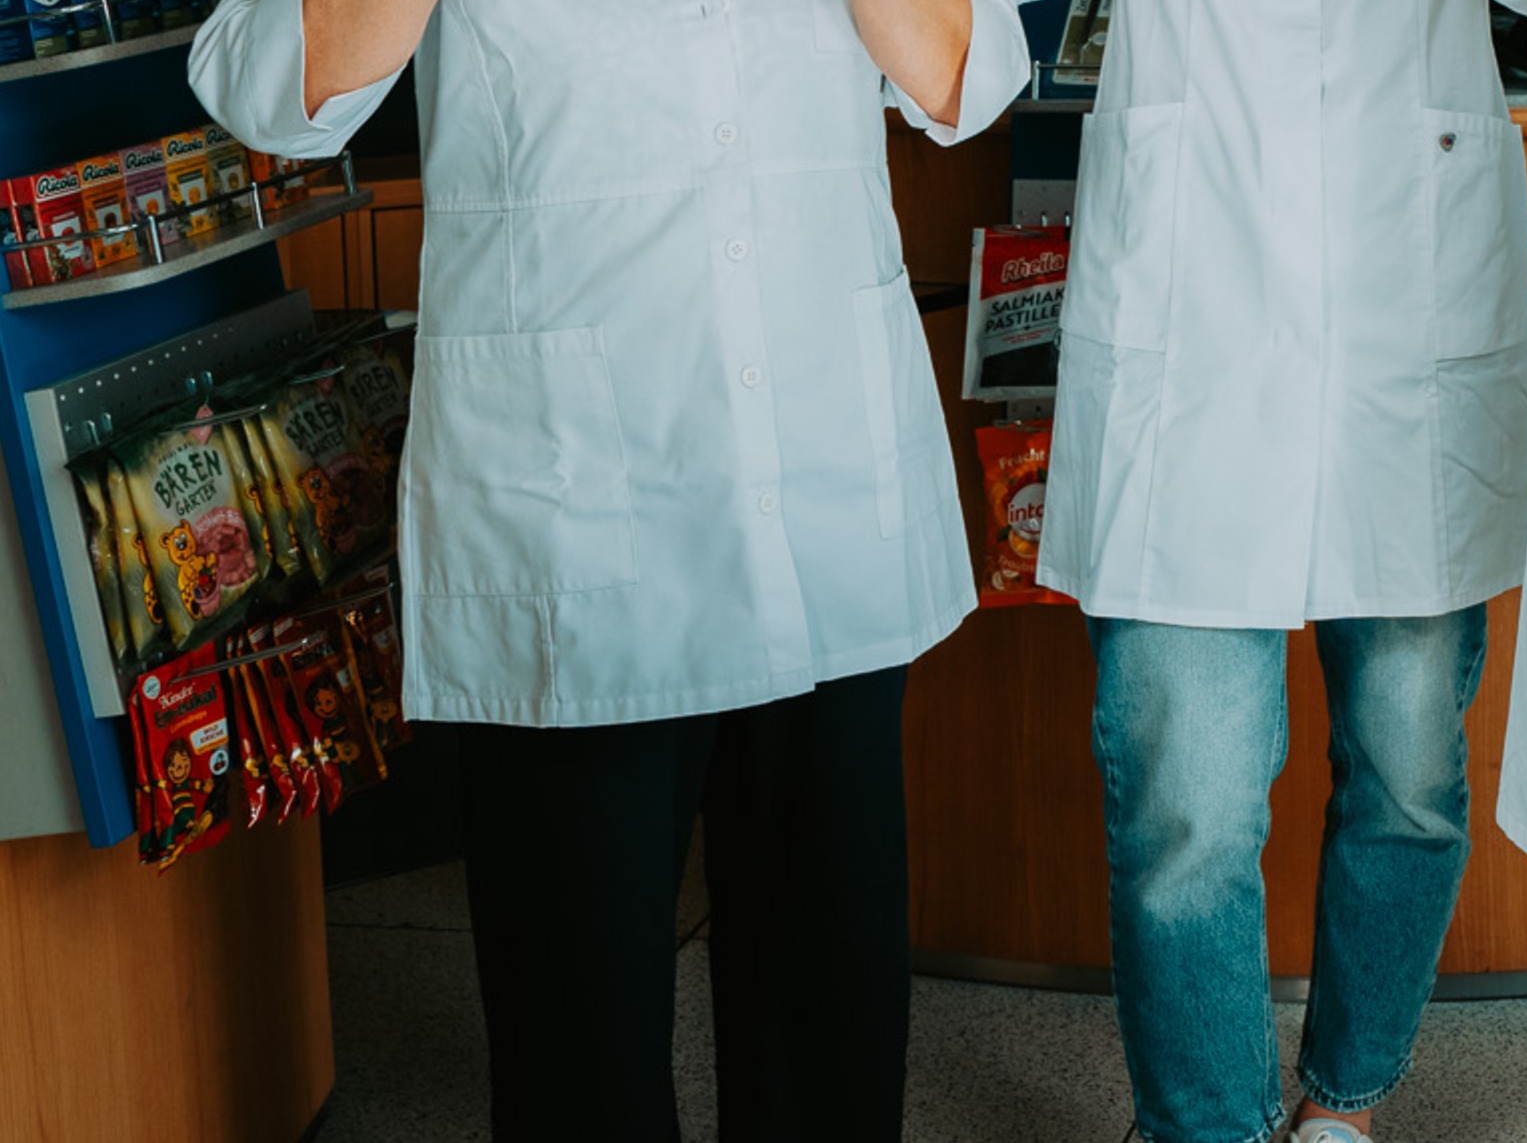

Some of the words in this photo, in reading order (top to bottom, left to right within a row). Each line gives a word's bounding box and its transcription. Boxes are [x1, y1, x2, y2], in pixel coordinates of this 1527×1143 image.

[126, 150, 163, 169] Ricola
[167, 138, 203, 157] Ricola
[38, 174, 78, 197] Ricola
[82, 163, 120, 182] Ricola
[1001, 251, 1066, 284] Rheila
[991, 287, 1065, 315] SALMIAK
[984, 304, 1060, 333] PASTILLE
[154, 450, 223, 509] BÄREN
[175, 479, 217, 516] GARTEN
